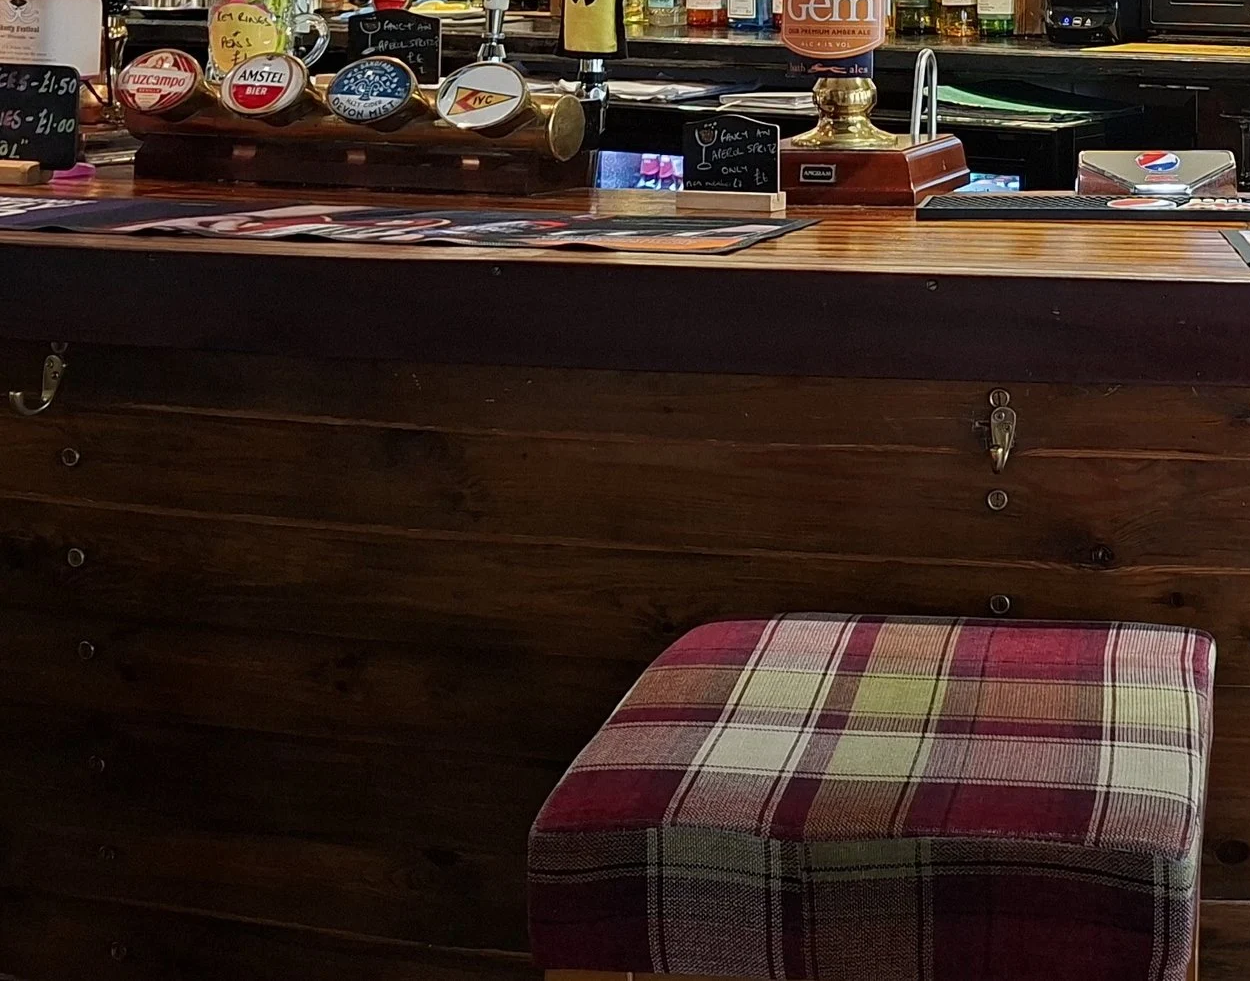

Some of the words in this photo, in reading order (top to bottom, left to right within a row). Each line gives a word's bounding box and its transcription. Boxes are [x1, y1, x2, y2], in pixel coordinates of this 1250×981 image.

[383, 19, 414, 31] FANCY
[416, 22, 432, 31] AN
[801, 28, 830, 36] PREMIUM
[377, 39, 408, 53] APEROL
[849, 63, 868, 74] ales
[38, 70, 77, 96] £1.50
[121, 72, 187, 89] Cruzcampo
[238, 70, 285, 84] AMSTEL
[245, 86, 268, 96] BIER
[472, 95, 493, 106] IYC
[332, 97, 364, 119] DEVON
[368, 100, 396, 118] MIST
[35, 108, 75, 135] £1.00
[720, 129, 749, 143] FANCY
[756, 128, 771, 138] AN
[711, 148, 745, 161] APEROL
[721, 164, 749, 174] ONLY
